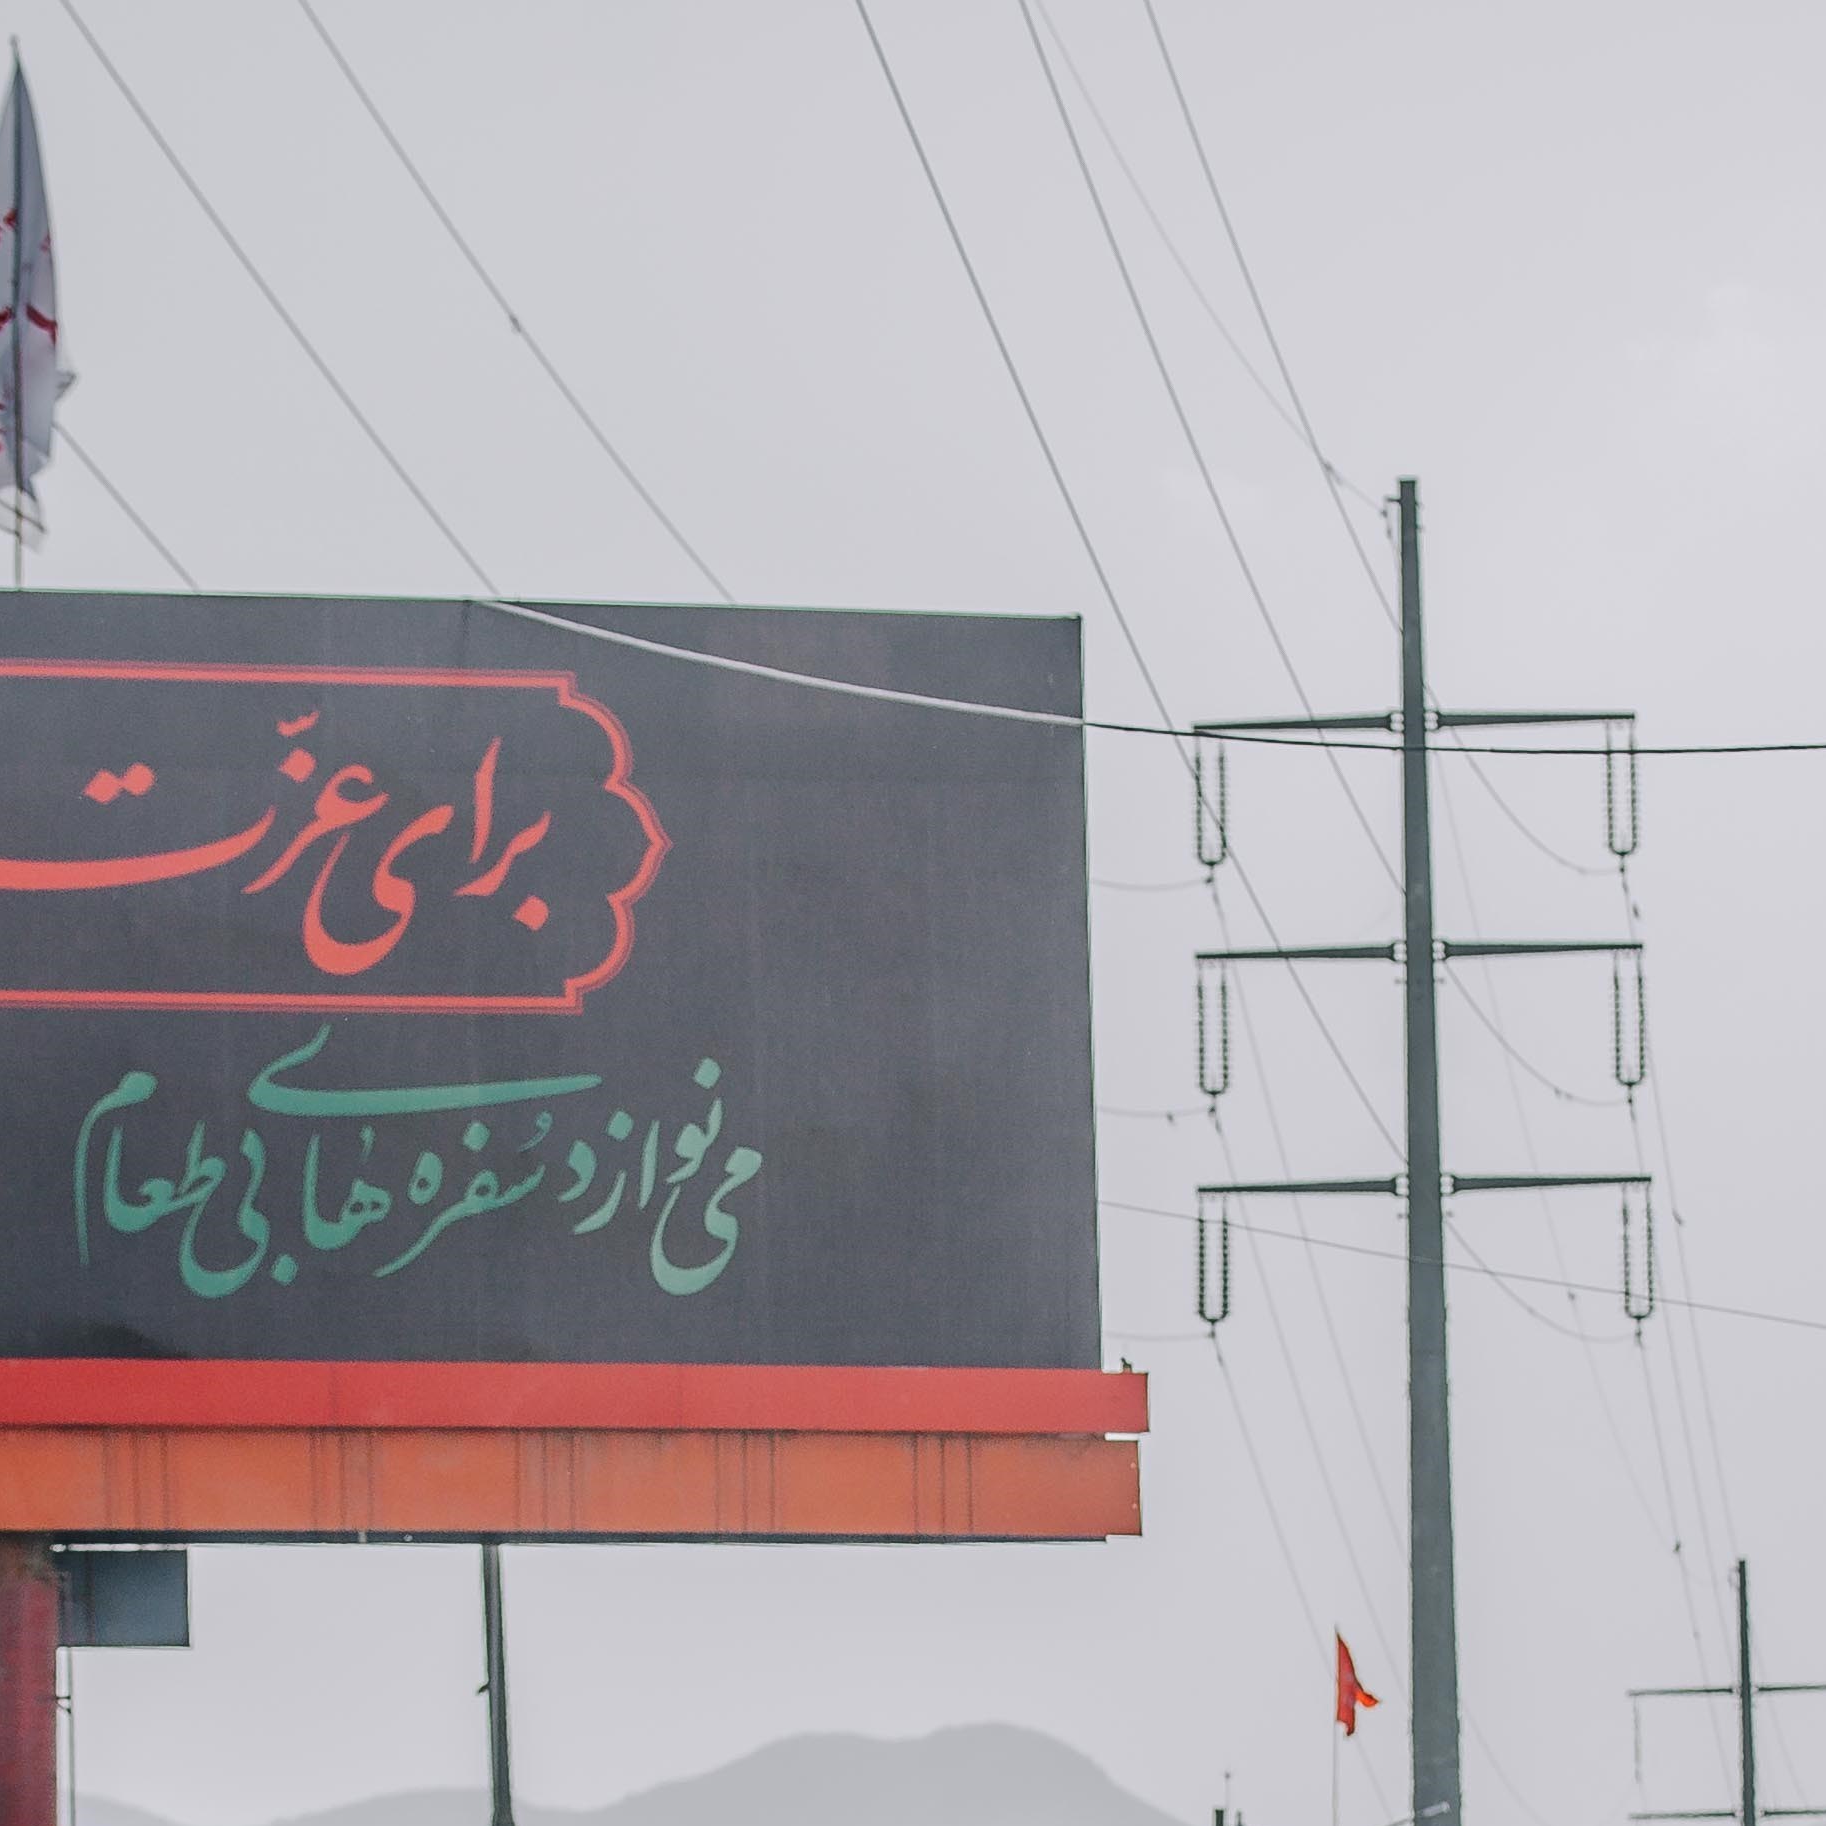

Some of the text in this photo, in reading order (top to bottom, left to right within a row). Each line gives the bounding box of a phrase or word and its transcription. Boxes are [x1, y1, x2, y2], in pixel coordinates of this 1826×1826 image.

[303, 737, 551, 974] برای
[75, 1071, 227, 1266] طعام
[179, 1127, 298, 1298] بی
[559, 1057, 723, 1236] نوازد
[649, 1146, 763, 1296] می
